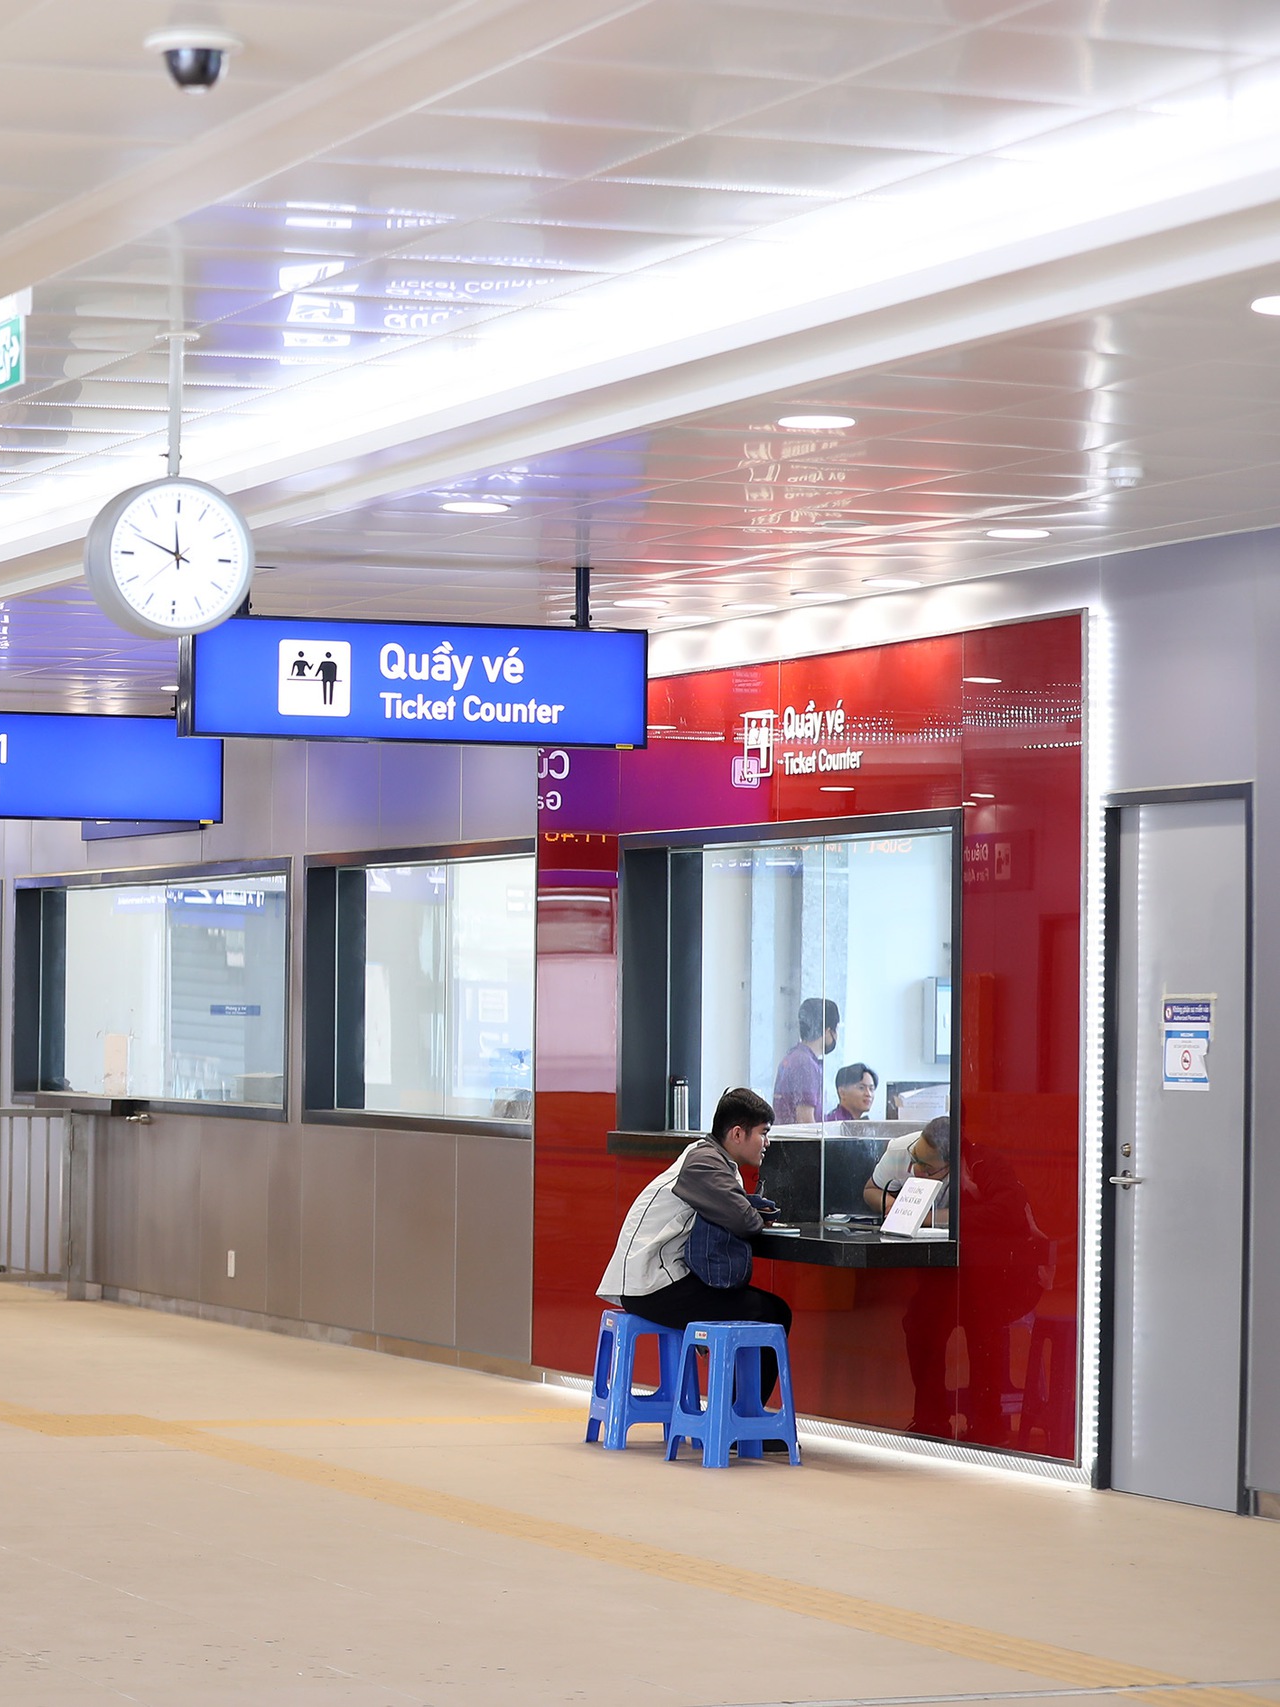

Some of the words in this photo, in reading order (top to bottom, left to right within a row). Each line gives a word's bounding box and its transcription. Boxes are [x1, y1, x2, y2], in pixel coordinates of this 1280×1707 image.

[379, 641, 474, 691] Quầy
[481, 647, 525, 684] vé
[379, 692, 457, 721] Ticket
[462, 695, 565, 724] Counter
[783, 699, 823, 744] Quầy
[825, 699, 845, 734] vé
[783, 750, 817, 775] Ticket
[818, 746, 863, 772] Counter
